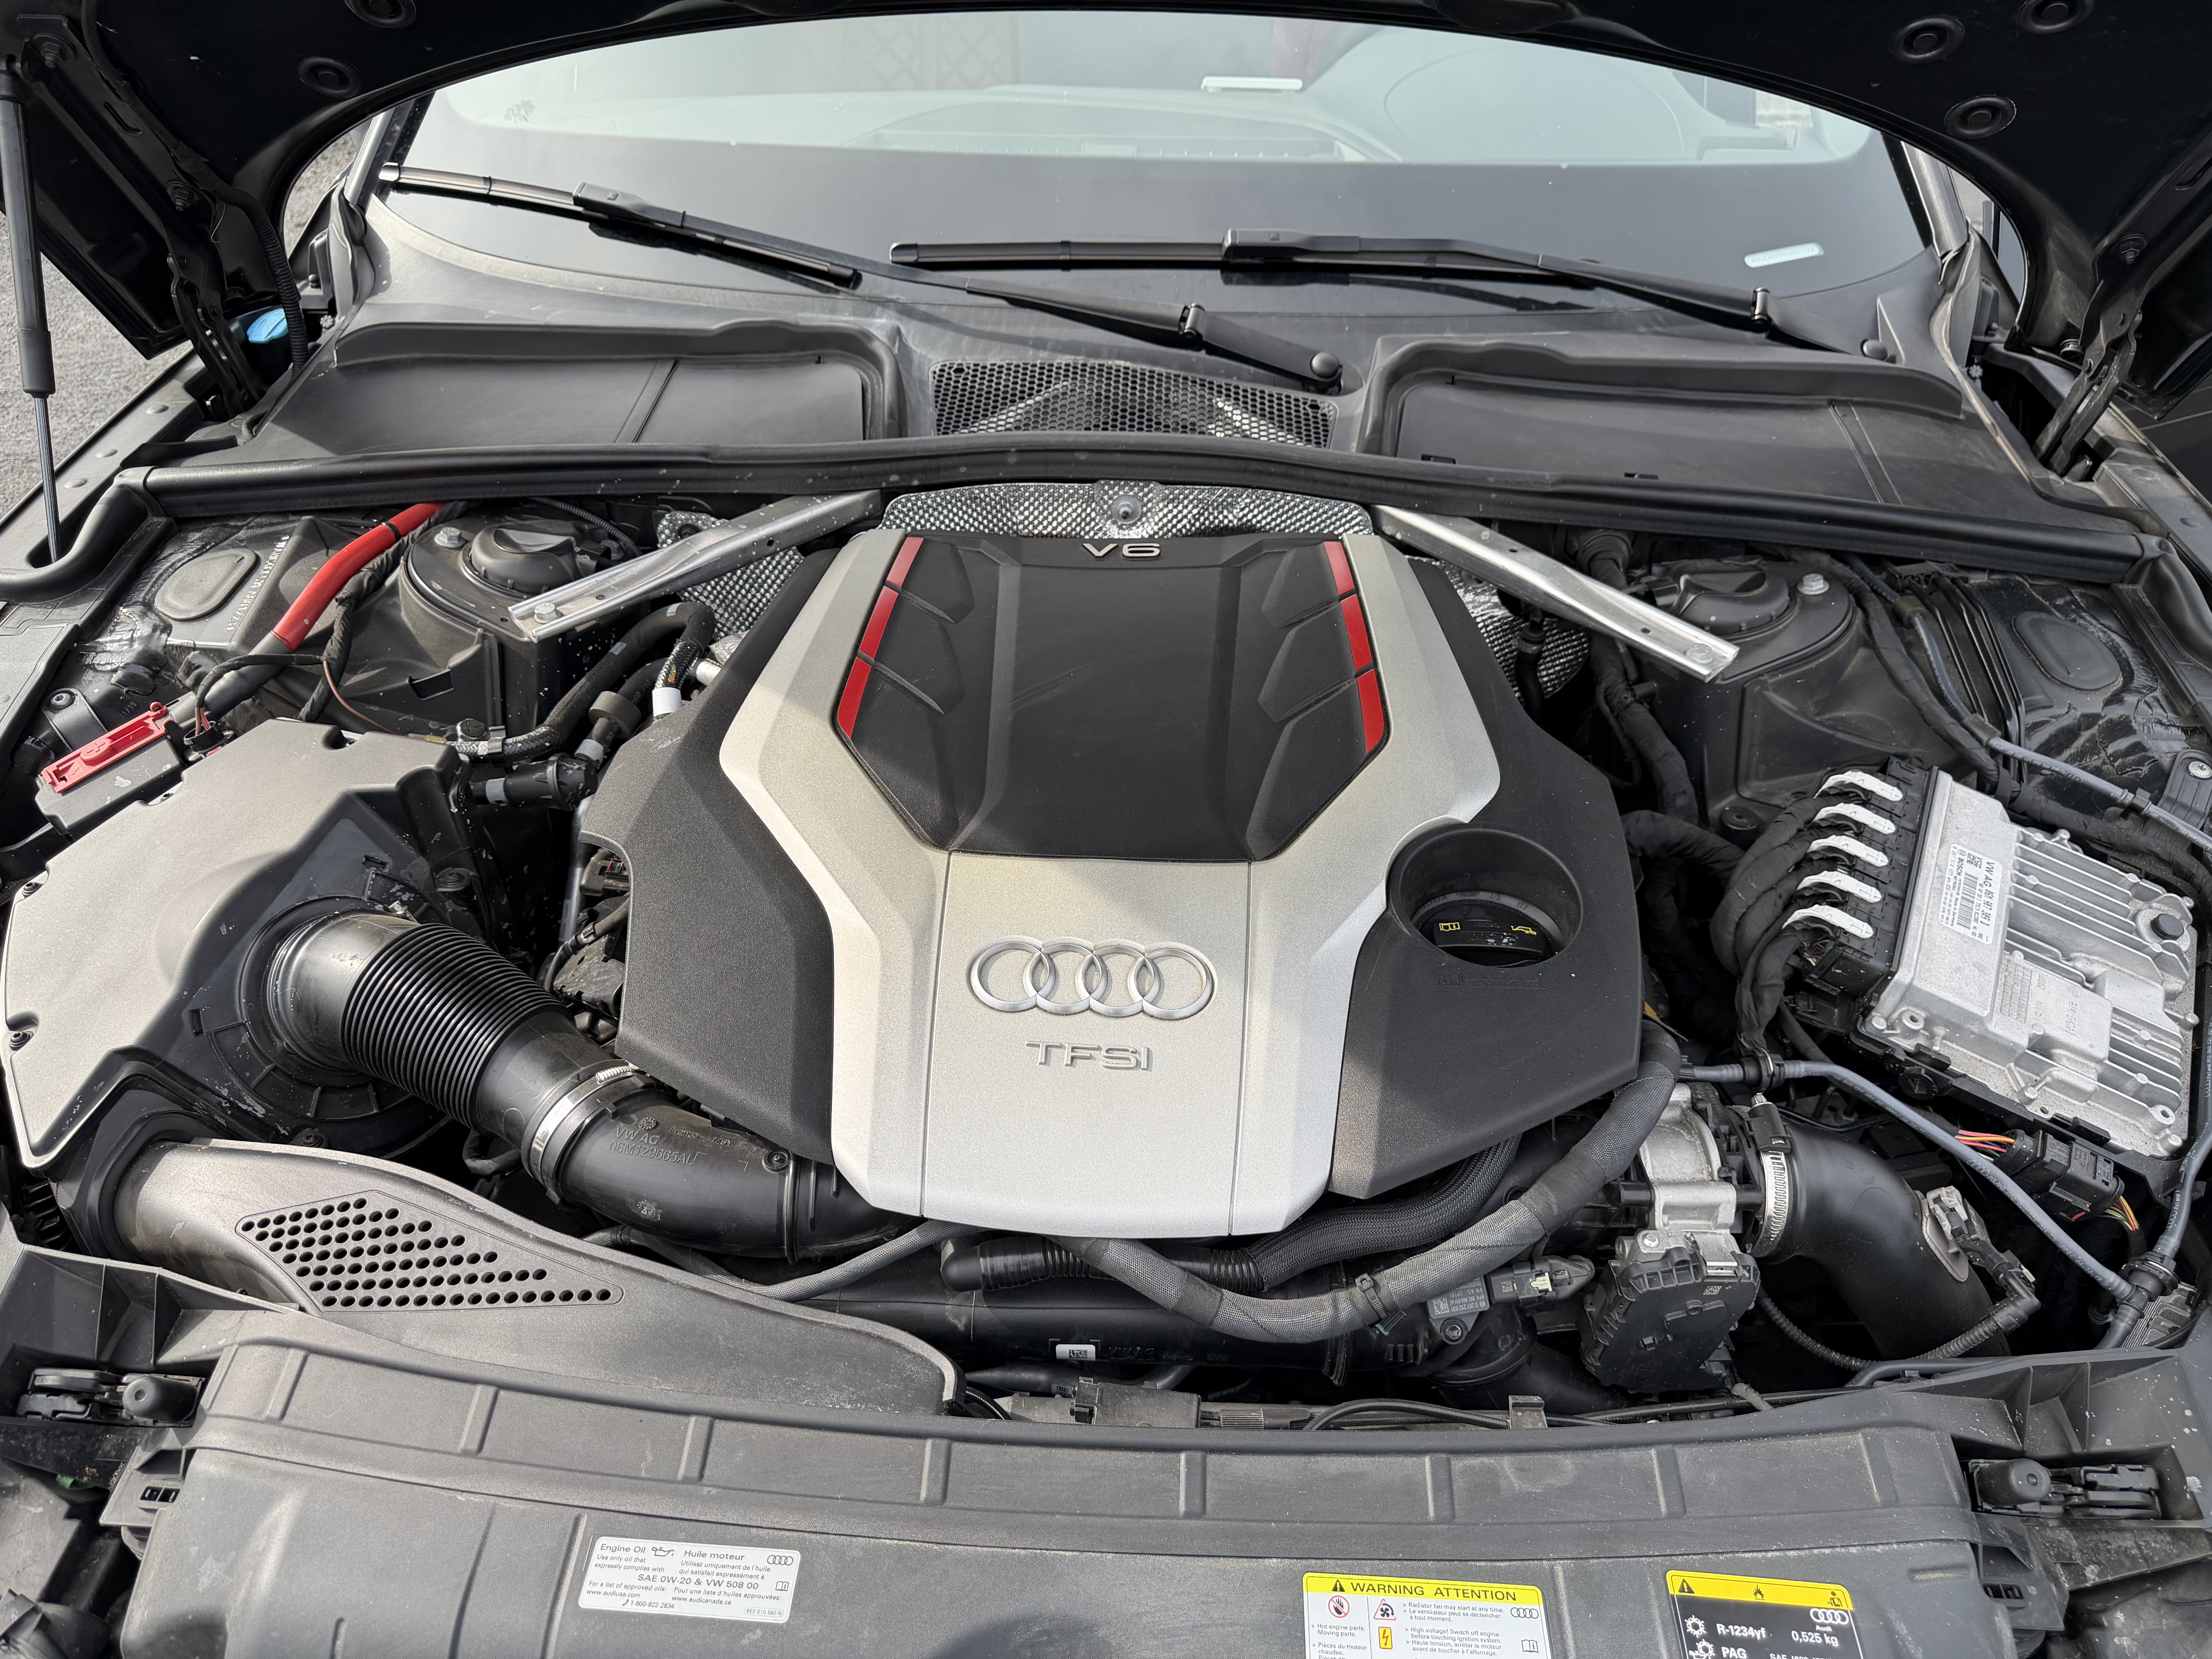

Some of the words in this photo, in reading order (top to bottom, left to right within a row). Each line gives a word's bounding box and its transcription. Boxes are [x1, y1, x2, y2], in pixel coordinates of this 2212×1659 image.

[1082, 542, 1161, 561] V6
[1956, 857, 1964, 876] BOSCH
[1985, 862, 1994, 875] VW
[1983, 874, 1992, 887] AG
[1025, 1041, 1151, 1071] TFSI
[616, 1127, 639, 1140] VW
[639, 1133, 661, 1145] AG
[610, 1141, 693, 1166] 06M129665AL
[600, 1544, 630, 1553] Engine
[684, 1550, 707, 1558] Huile
[710, 1552, 745, 1560] moteur
[660, 1576, 691, 1585] 0W-20
[586, 1590, 640, 1598] www.audiusa.com
[1351, 1582, 1424, 1595] WARNING
[1434, 1587, 1516, 1601] ATTENTION
[630, 1600, 674, 1609] 1-800-822-2834
[672, 1596, 731, 1605] www.audicanada.ca
[1716, 1623, 1766, 1640] R-1234yf
[1791, 1630, 1822, 1643] 0,525
[1824, 1633, 1839, 1647] kg
[1721, 1647, 1747, 1659] PAG
